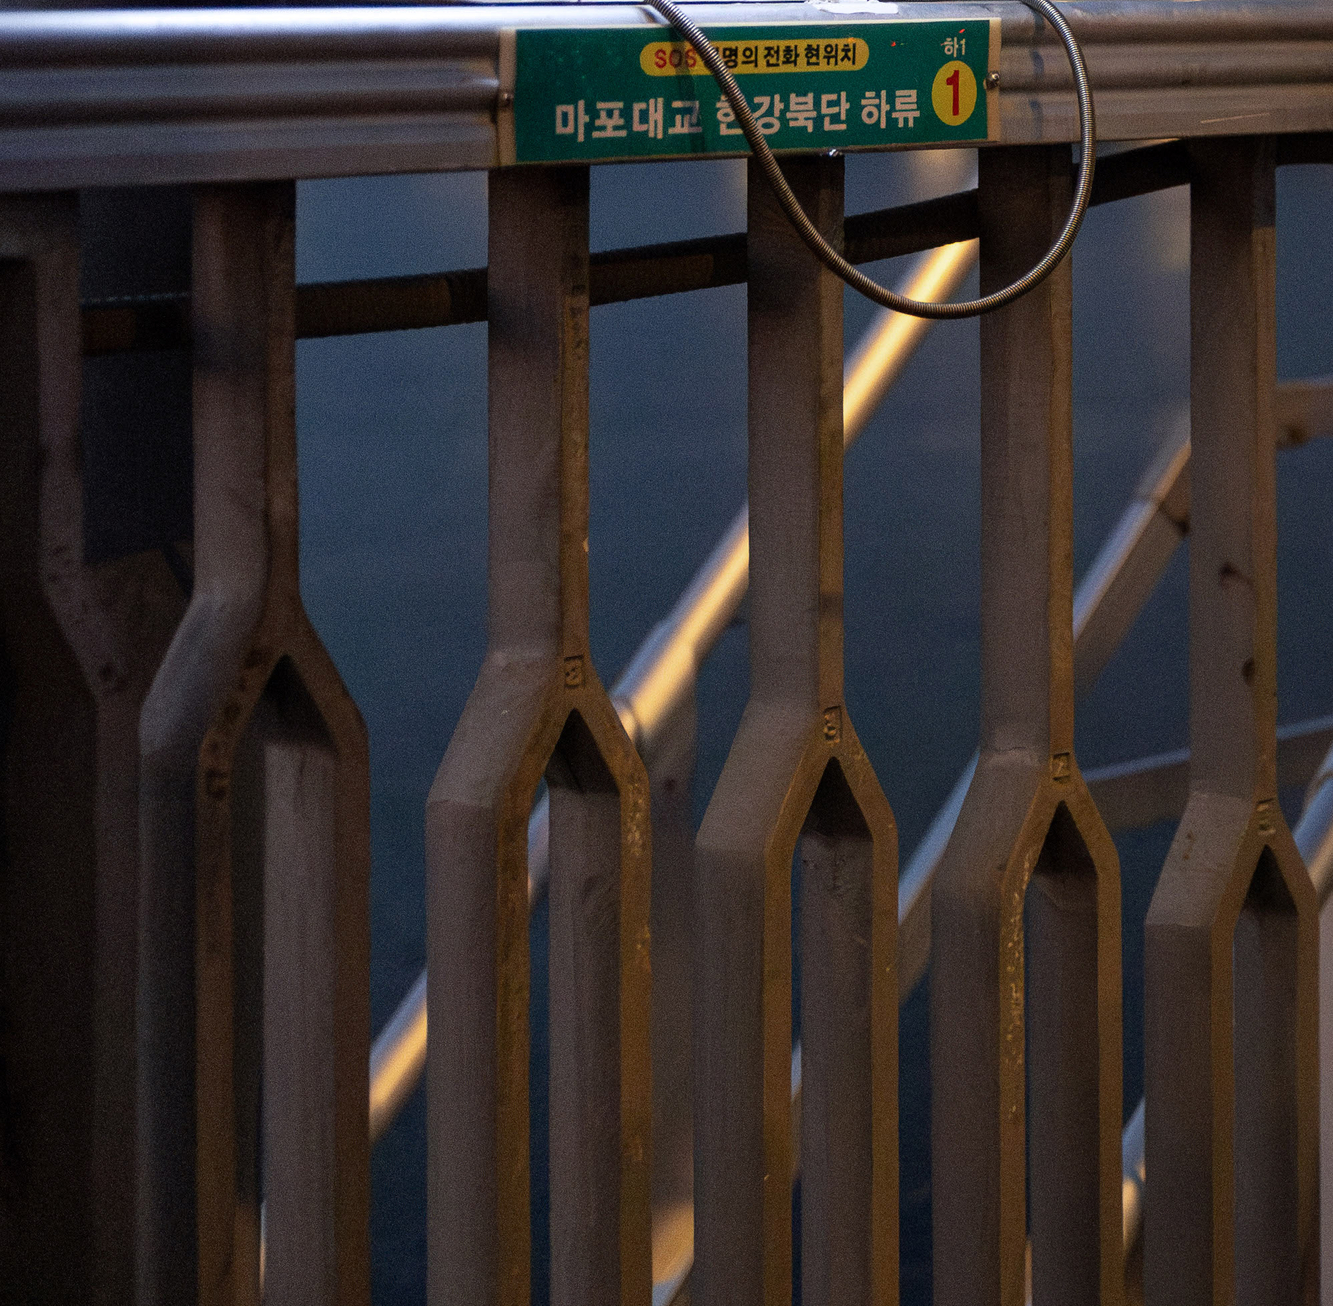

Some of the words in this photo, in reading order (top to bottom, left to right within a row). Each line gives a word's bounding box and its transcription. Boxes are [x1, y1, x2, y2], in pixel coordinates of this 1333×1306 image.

[654, 48, 698, 69] SOS
[714, 46, 758, 68] 명의
[764, 44, 799, 67] 전화
[804, 43, 857, 66] 현위치
[944, 37, 966, 58] 하1
[946, 69, 959, 116] 1
[555, 97, 702, 143] 마포대교
[861, 90, 920, 129] 하류
